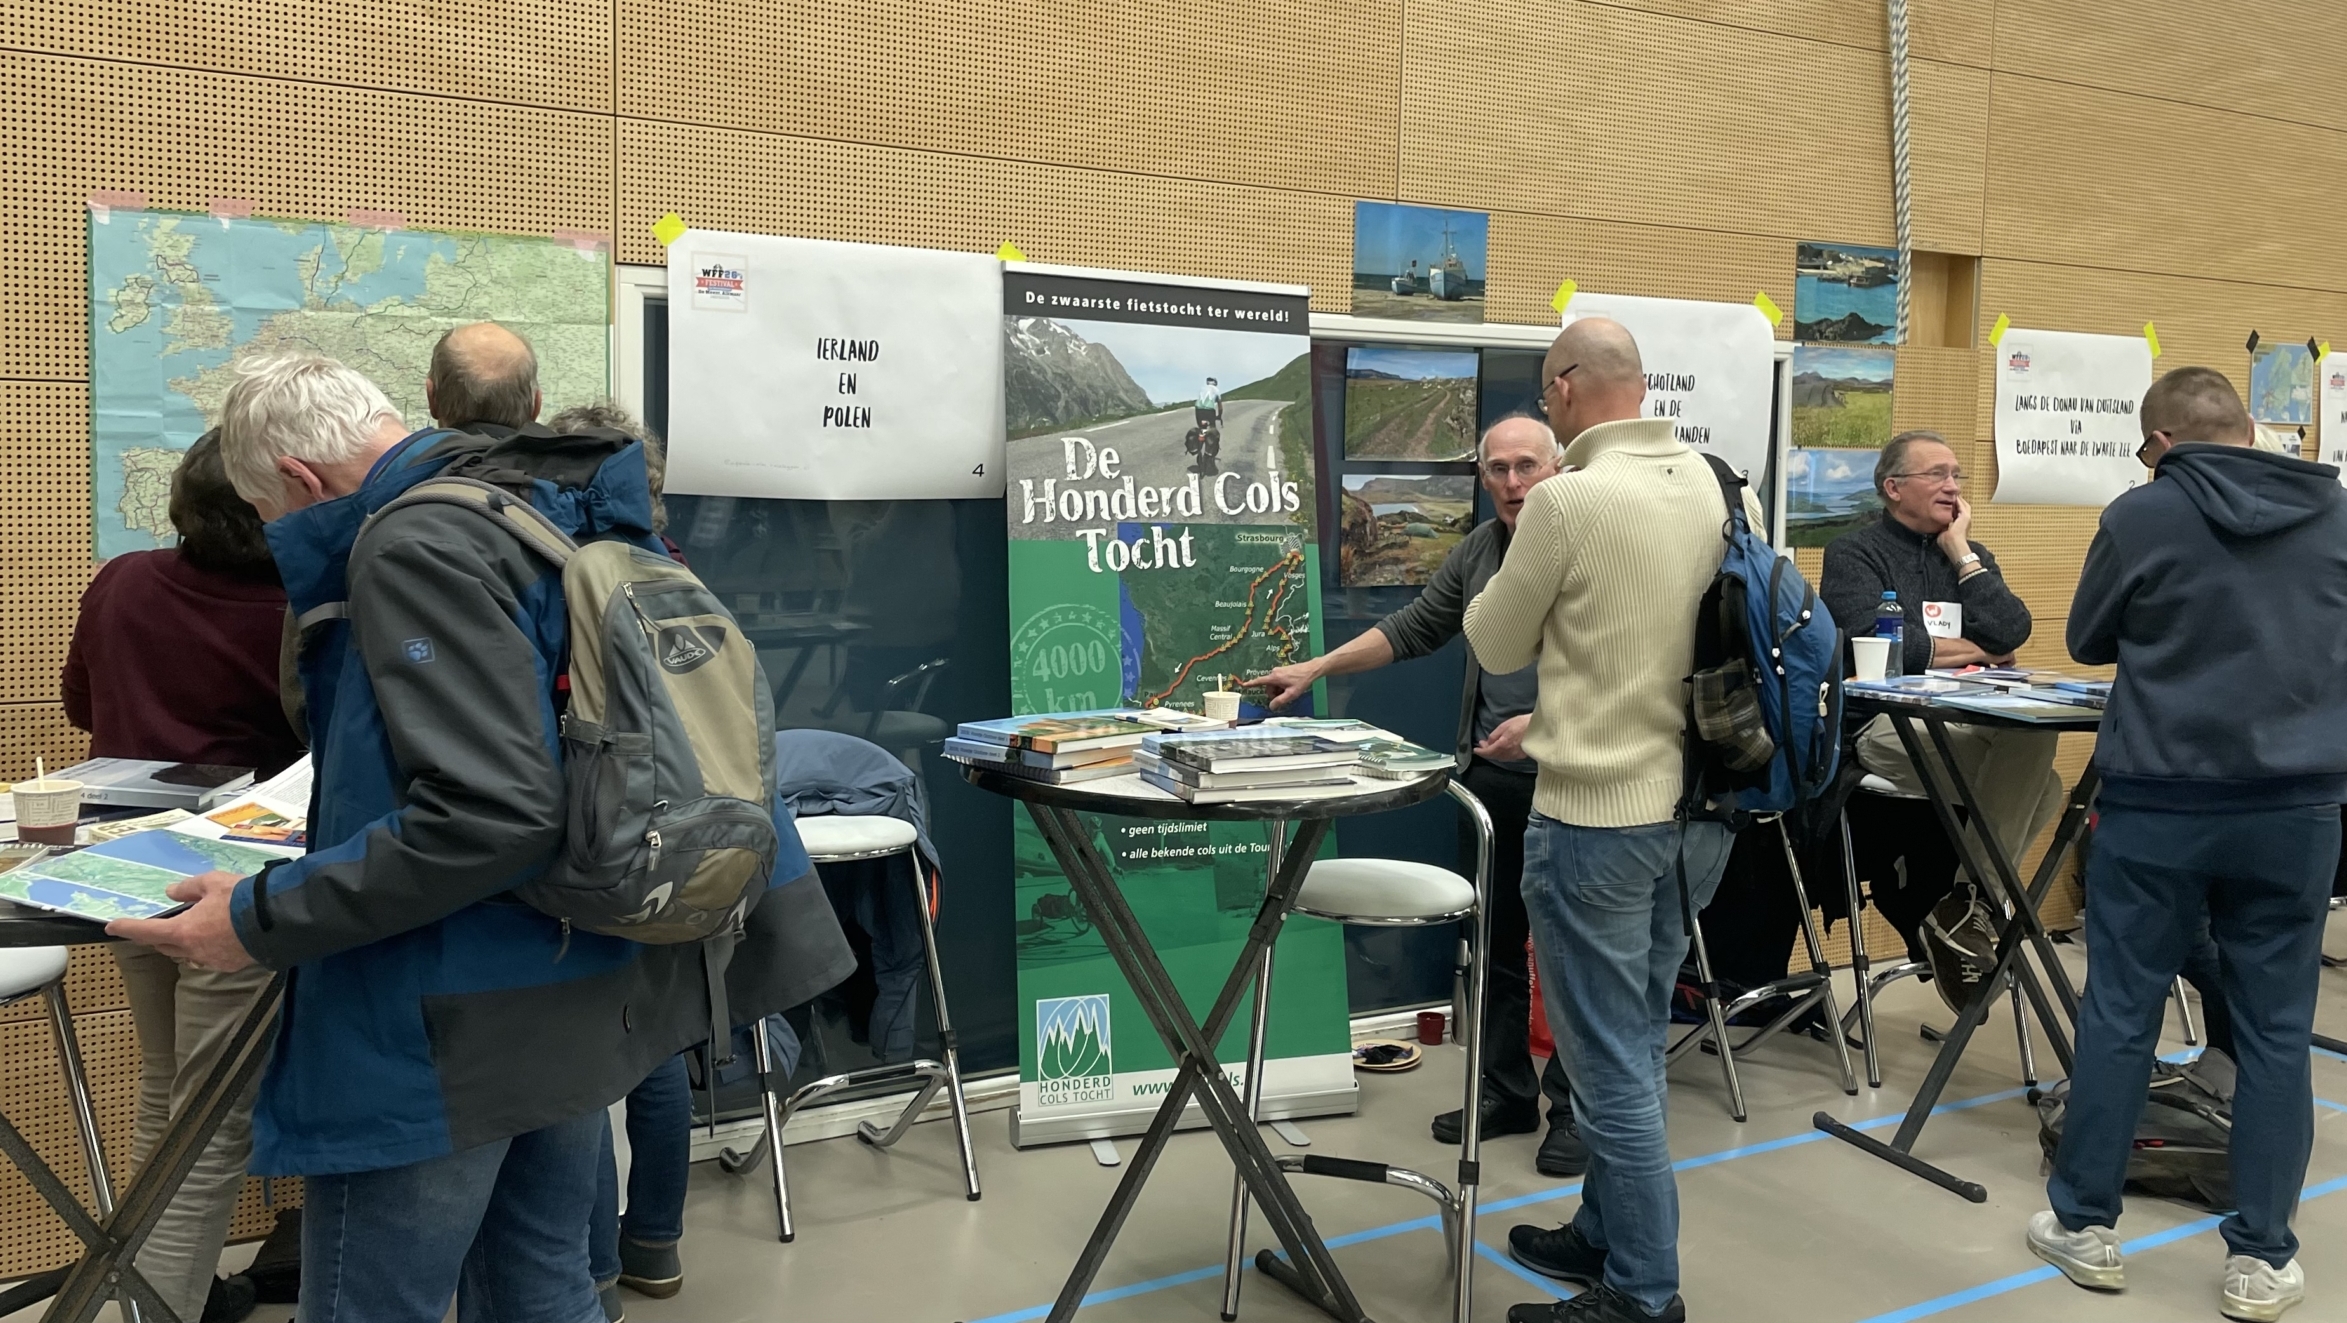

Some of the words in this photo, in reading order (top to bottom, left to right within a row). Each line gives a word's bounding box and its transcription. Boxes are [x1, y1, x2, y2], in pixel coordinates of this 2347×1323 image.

[1026, 291, 1044, 304] De
[1052, 295, 1120, 310] zwaarste
[1127, 299, 1202, 316] fietstocht
[1208, 305, 1229, 318] ter
[1235, 309, 1289, 322] wereld!
[817, 338, 879, 362] IERLAND
[839, 372, 856, 394] EN
[1644, 373, 1695, 392] CHOTLAND
[1654, 400, 1665, 417] EN
[1669, 400, 1682, 418] DE
[2016, 395, 2037, 411] LANGS
[2040, 396, 2050, 411] DE
[2053, 397, 2078, 412] DONAU
[2080, 398, 2094, 413] VAN
[823, 406, 870, 428] POLEN
[1675, 426, 1710, 444] LANDEN
[2016, 440, 2058, 455] BOEDAPEST
[2060, 441, 2077, 455] NAAR
[2080, 441, 2089, 456] DE
[2092, 442, 2116, 457] ZWARTE
[2119, 442, 2130, 458] ZEE
[1060, 437, 1120, 480] De
[972, 464, 985, 477] 4
[1019, 472, 1203, 524] Honderd
[1214, 471, 1300, 516] Cols
[1237, 534, 1284, 543] Strasbourg
[1076, 526, 1197, 573] Tocht
[1927, 620, 1951, 629] VLADY
[1032, 640, 1106, 682] 4000
[1045, 688, 1097, 714] km
[1164, 700, 1195, 708] Pyrenees
[1129, 825, 1154, 837] geen
[1157, 822, 1207, 836] tijdslimiet
[1130, 849, 1148, 859] alle
[1151, 847, 1194, 858] bekende
[1198, 846, 1216, 856] cols
[1219, 844, 1232, 854] uit
[1234, 844, 1247, 854] de
[1040, 1076, 1111, 1093] HONDERD
[1040, 1091, 1068, 1106] COLS
[1073, 1088, 1111, 1102] TOCHT
